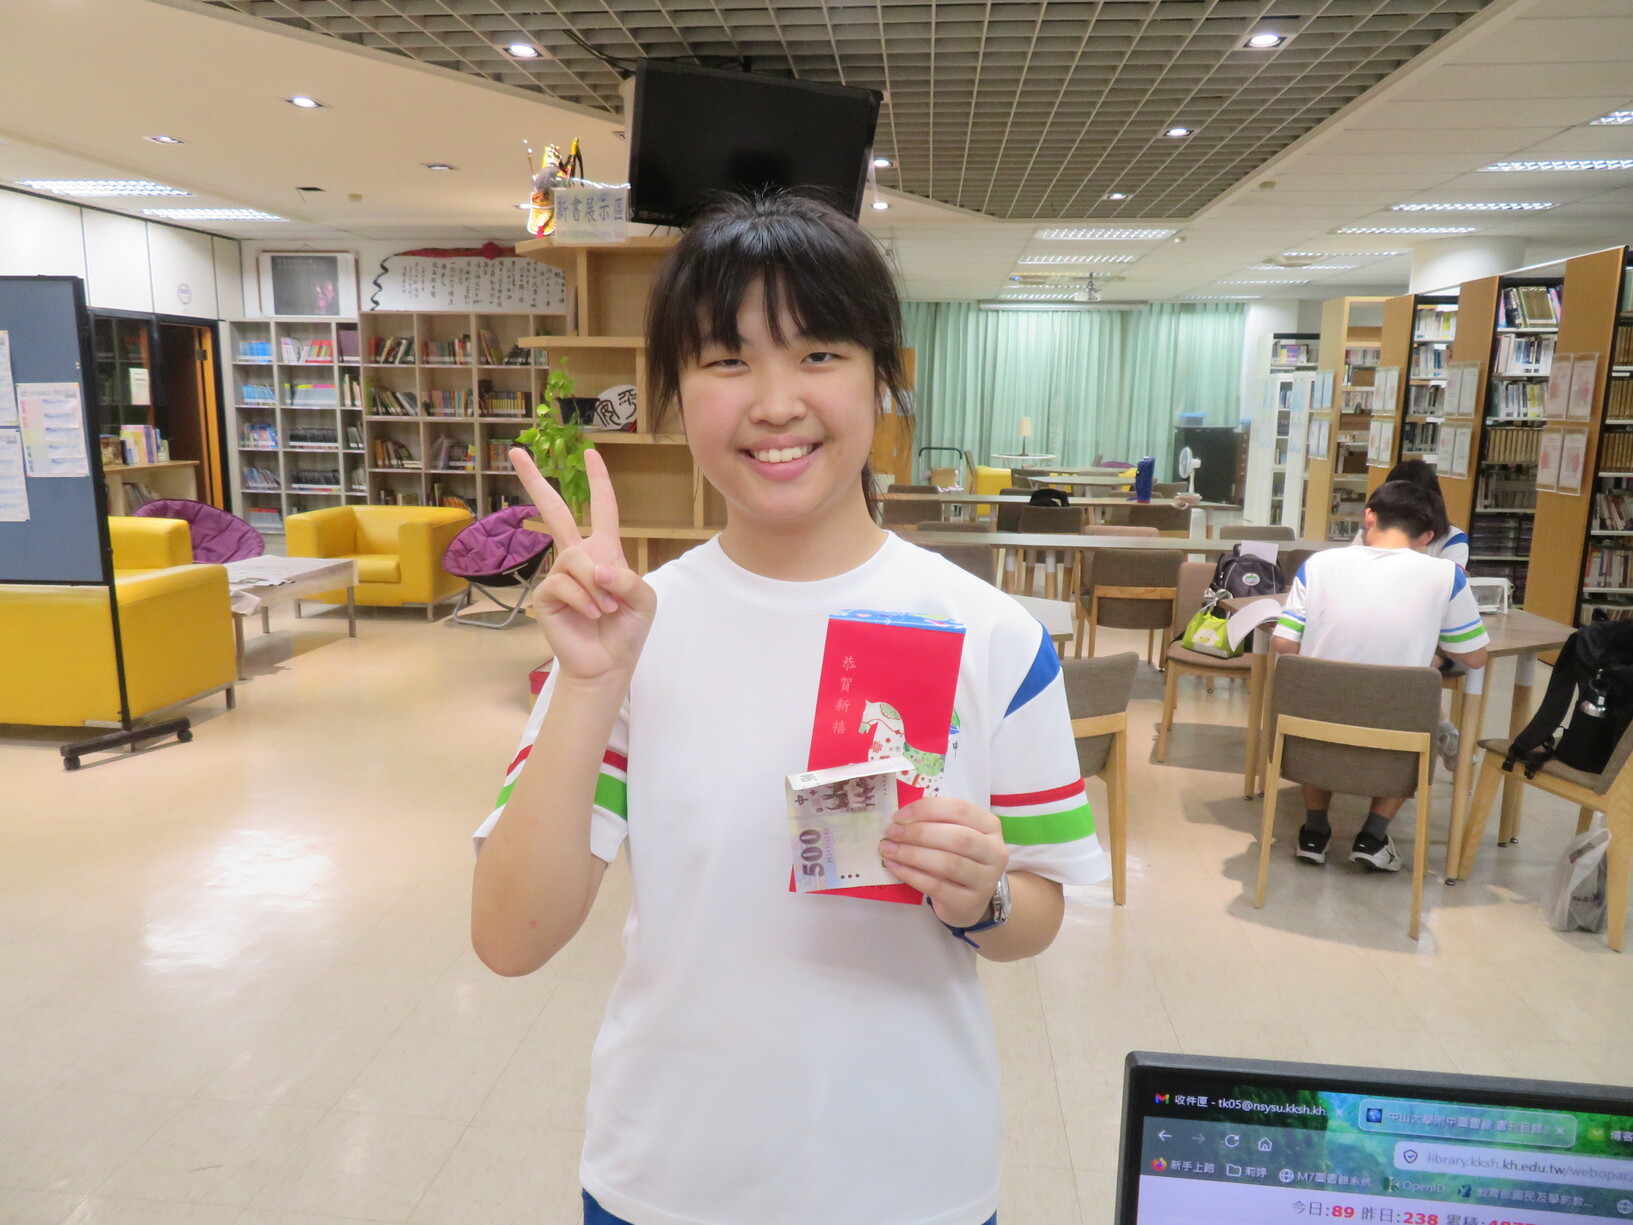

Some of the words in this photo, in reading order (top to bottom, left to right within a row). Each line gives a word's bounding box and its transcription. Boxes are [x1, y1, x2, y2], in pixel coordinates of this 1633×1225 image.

[556, 196, 624, 222] 新書展示區
[832, 655, 857, 735] 恭賀新禧
[799, 828, 826, 877] 500
[1174, 1094, 1209, 1109] 收件匣
[1170, 1159, 1215, 1174] 新手上路
[1402, 1180, 1445, 1194] OpenID
